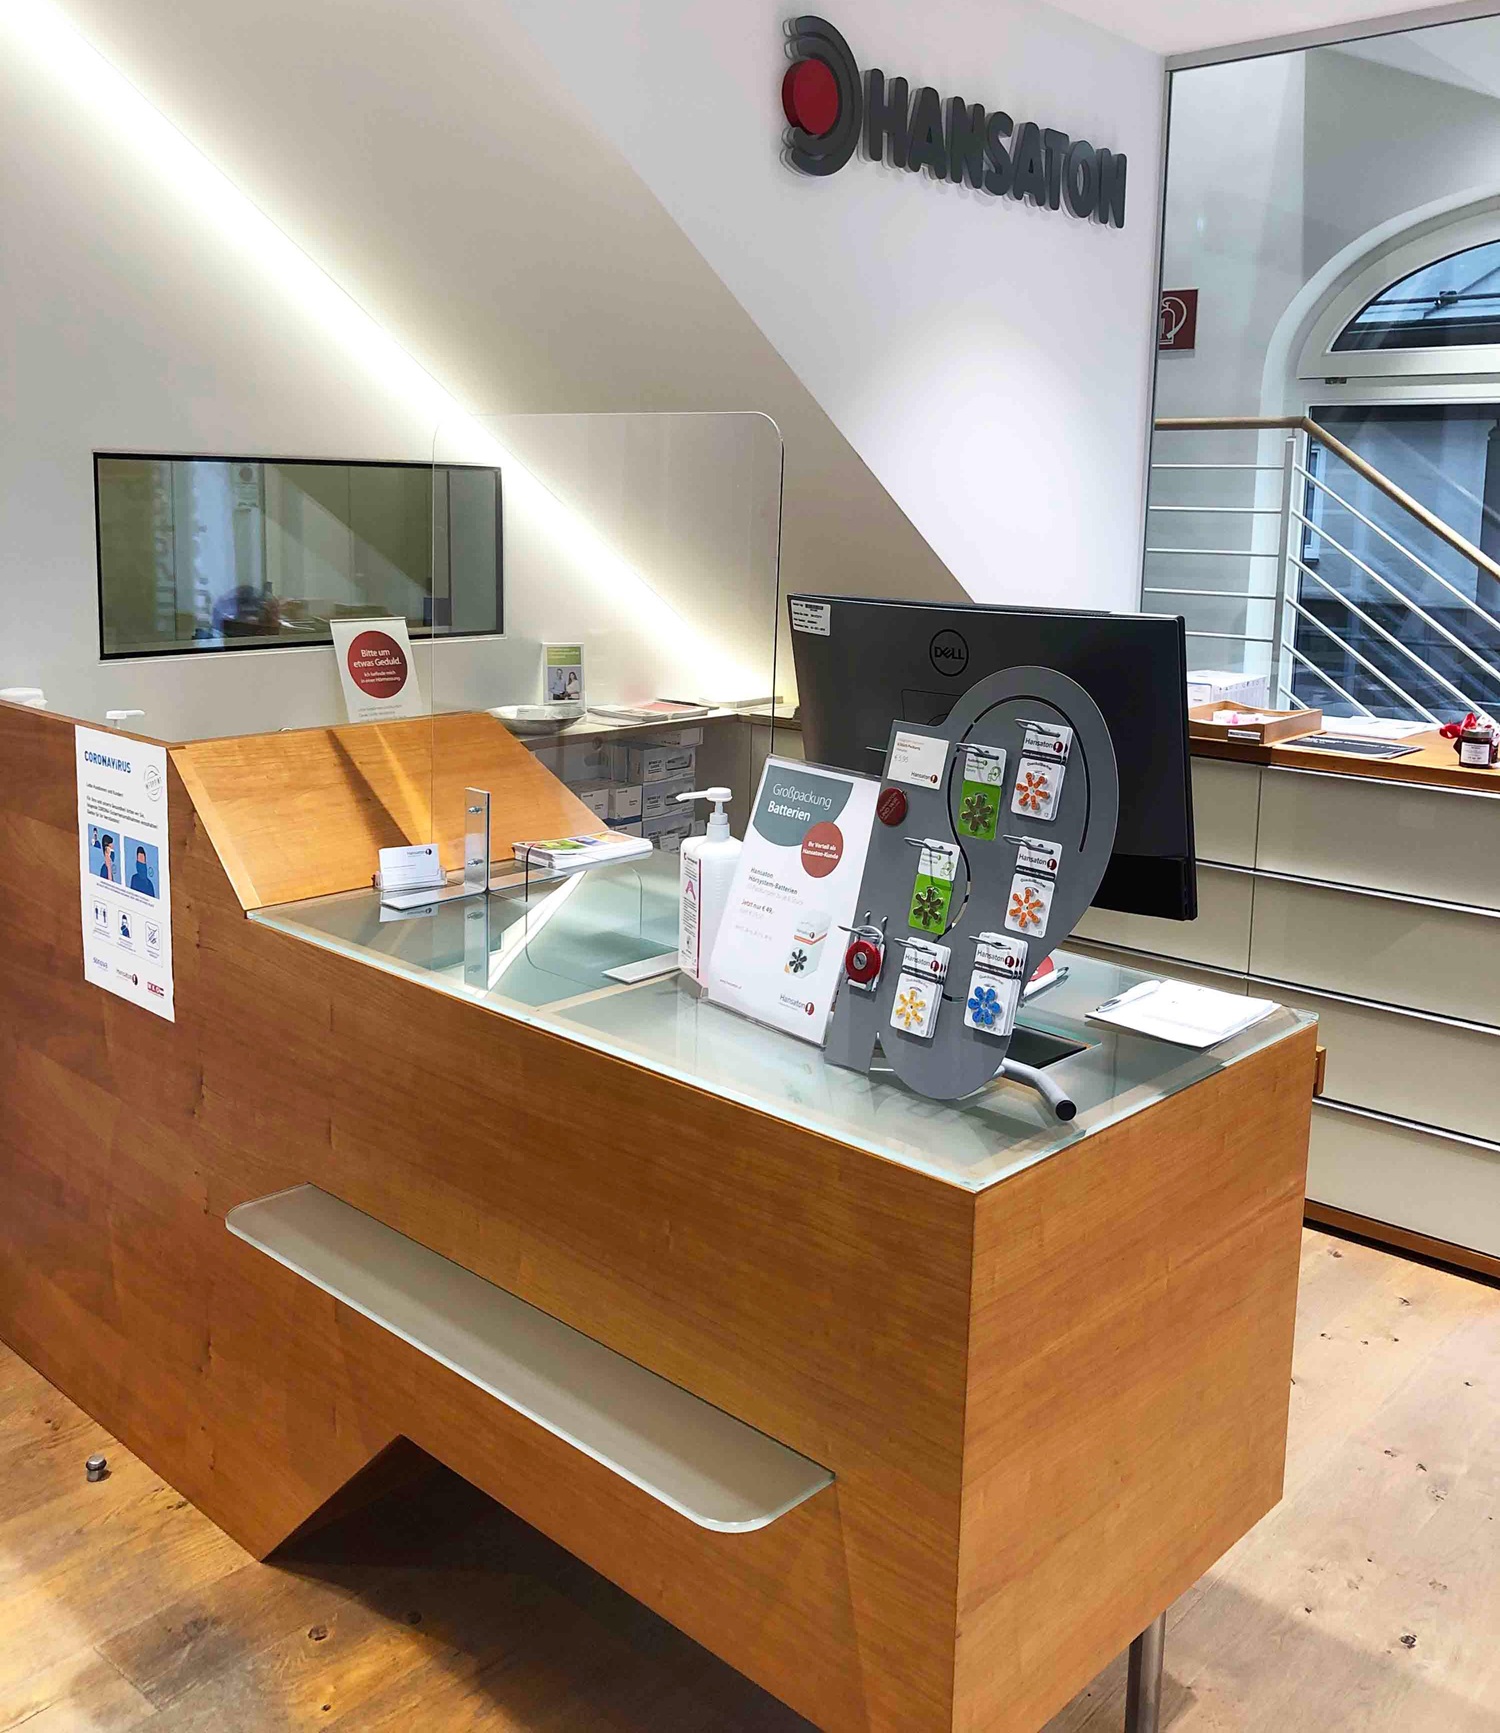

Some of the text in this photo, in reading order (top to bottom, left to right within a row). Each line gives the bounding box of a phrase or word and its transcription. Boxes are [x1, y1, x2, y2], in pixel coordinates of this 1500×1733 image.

[860, 68, 1127, 228] HANSATON
[361, 649, 378, 658] Bitte
[934, 646, 965, 660] DELL
[353, 657, 402, 668] etwas Geduld.
[1025, 738, 1053, 748] Hansaton
[773, 783, 832, 811] Großpackung
[767, 800, 811, 822] Batterien
[815, 842, 830, 850] Vorteil
[1019, 854, 1047, 866] Hansaton
[750, 867, 774, 879] Hansaton
[905, 954, 930, 966] Hansaton
[977, 949, 1005, 962] Hansaton
[780, 993, 806, 1009] Hansaton
